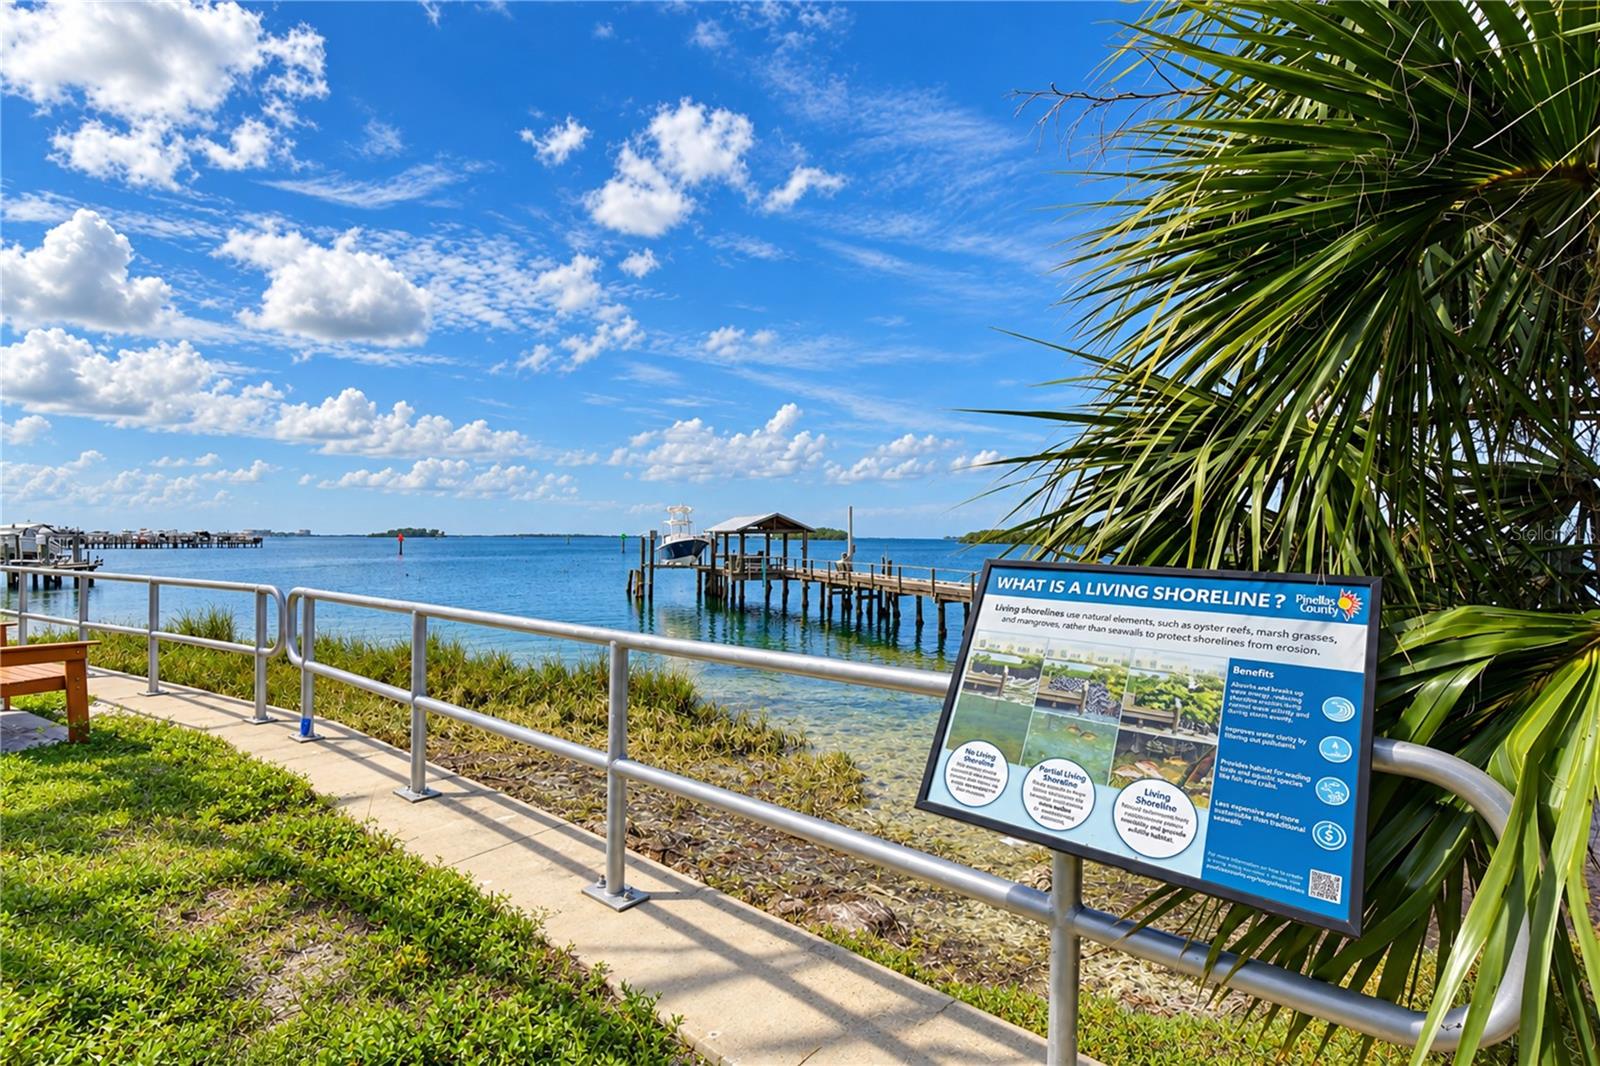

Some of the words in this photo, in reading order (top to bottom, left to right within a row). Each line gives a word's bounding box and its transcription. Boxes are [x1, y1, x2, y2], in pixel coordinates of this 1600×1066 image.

[998, 577, 1046, 592] WHAT
[1049, 580, 1065, 593] IS
[1068, 581, 1081, 595] A
[1086, 582, 1149, 599] LIVING
[1152, 586, 1271, 608] SHORELINE
[1275, 594, 1286, 609] ?
[1296, 593, 1336, 607] Pinellas
[1299, 604, 1339, 618] County
[995, 603, 1020, 614] Living
[1021, 606, 1065, 618] shorelines
[1066, 611, 1080, 619] use
[1082, 611, 1111, 622] natural
[1113, 615, 1155, 627] elements,
[1158, 619, 1179, 629] such
[1181, 622, 1191, 630] as
[1193, 622, 1224, 634] oyster
[1226, 625, 1254, 636] reefs,
[1256, 628, 1289, 639] marsh
[1292, 632, 1338, 644] grasses,
[1001, 616, 1015, 624] and
[1017, 618, 1061, 629] mangroves,
[1062, 621, 1086, 631] rather
[1088, 624, 1106, 633] than
[1108, 626, 1144, 638] seawalls
[1145, 630, 1155, 639] to
[1156, 631, 1191, 644] protect
[1193, 635, 1245, 648] shorelines
[1247, 639, 1273, 650] from
[1276, 644, 1320, 656] erosion.
[1233, 666, 1274, 678] Benefits
[1225, 726, 1255, 736] Improves
[1276, 734, 1297, 744] clarity
[1298, 737, 1307, 746] by
[1250, 736, 1260, 744] out
[965, 748, 975, 756] No
[976, 750, 997, 762] Living
[1039, 765, 1063, 777] Partial
[1064, 771, 1087, 784] Living
[1220, 758, 1248, 770] Provides
[1250, 764, 1272, 774] habitat
[1274, 768, 1284, 776] for
[1285, 771, 1311, 783] wading
[1043, 774, 1078, 789] Shoreline
[1244, 778, 1257, 786] and
[1277, 777, 1303, 788] species
[1144, 788, 1171, 803] Living
[1135, 796, 1177, 813] Shoreline
[1215, 800, 1230, 809] Less
[1231, 804, 1265, 816] expensive
[1266, 812, 1280, 820] and
[1280, 815, 1300, 824] more
[1253, 815, 1269, 826] than
